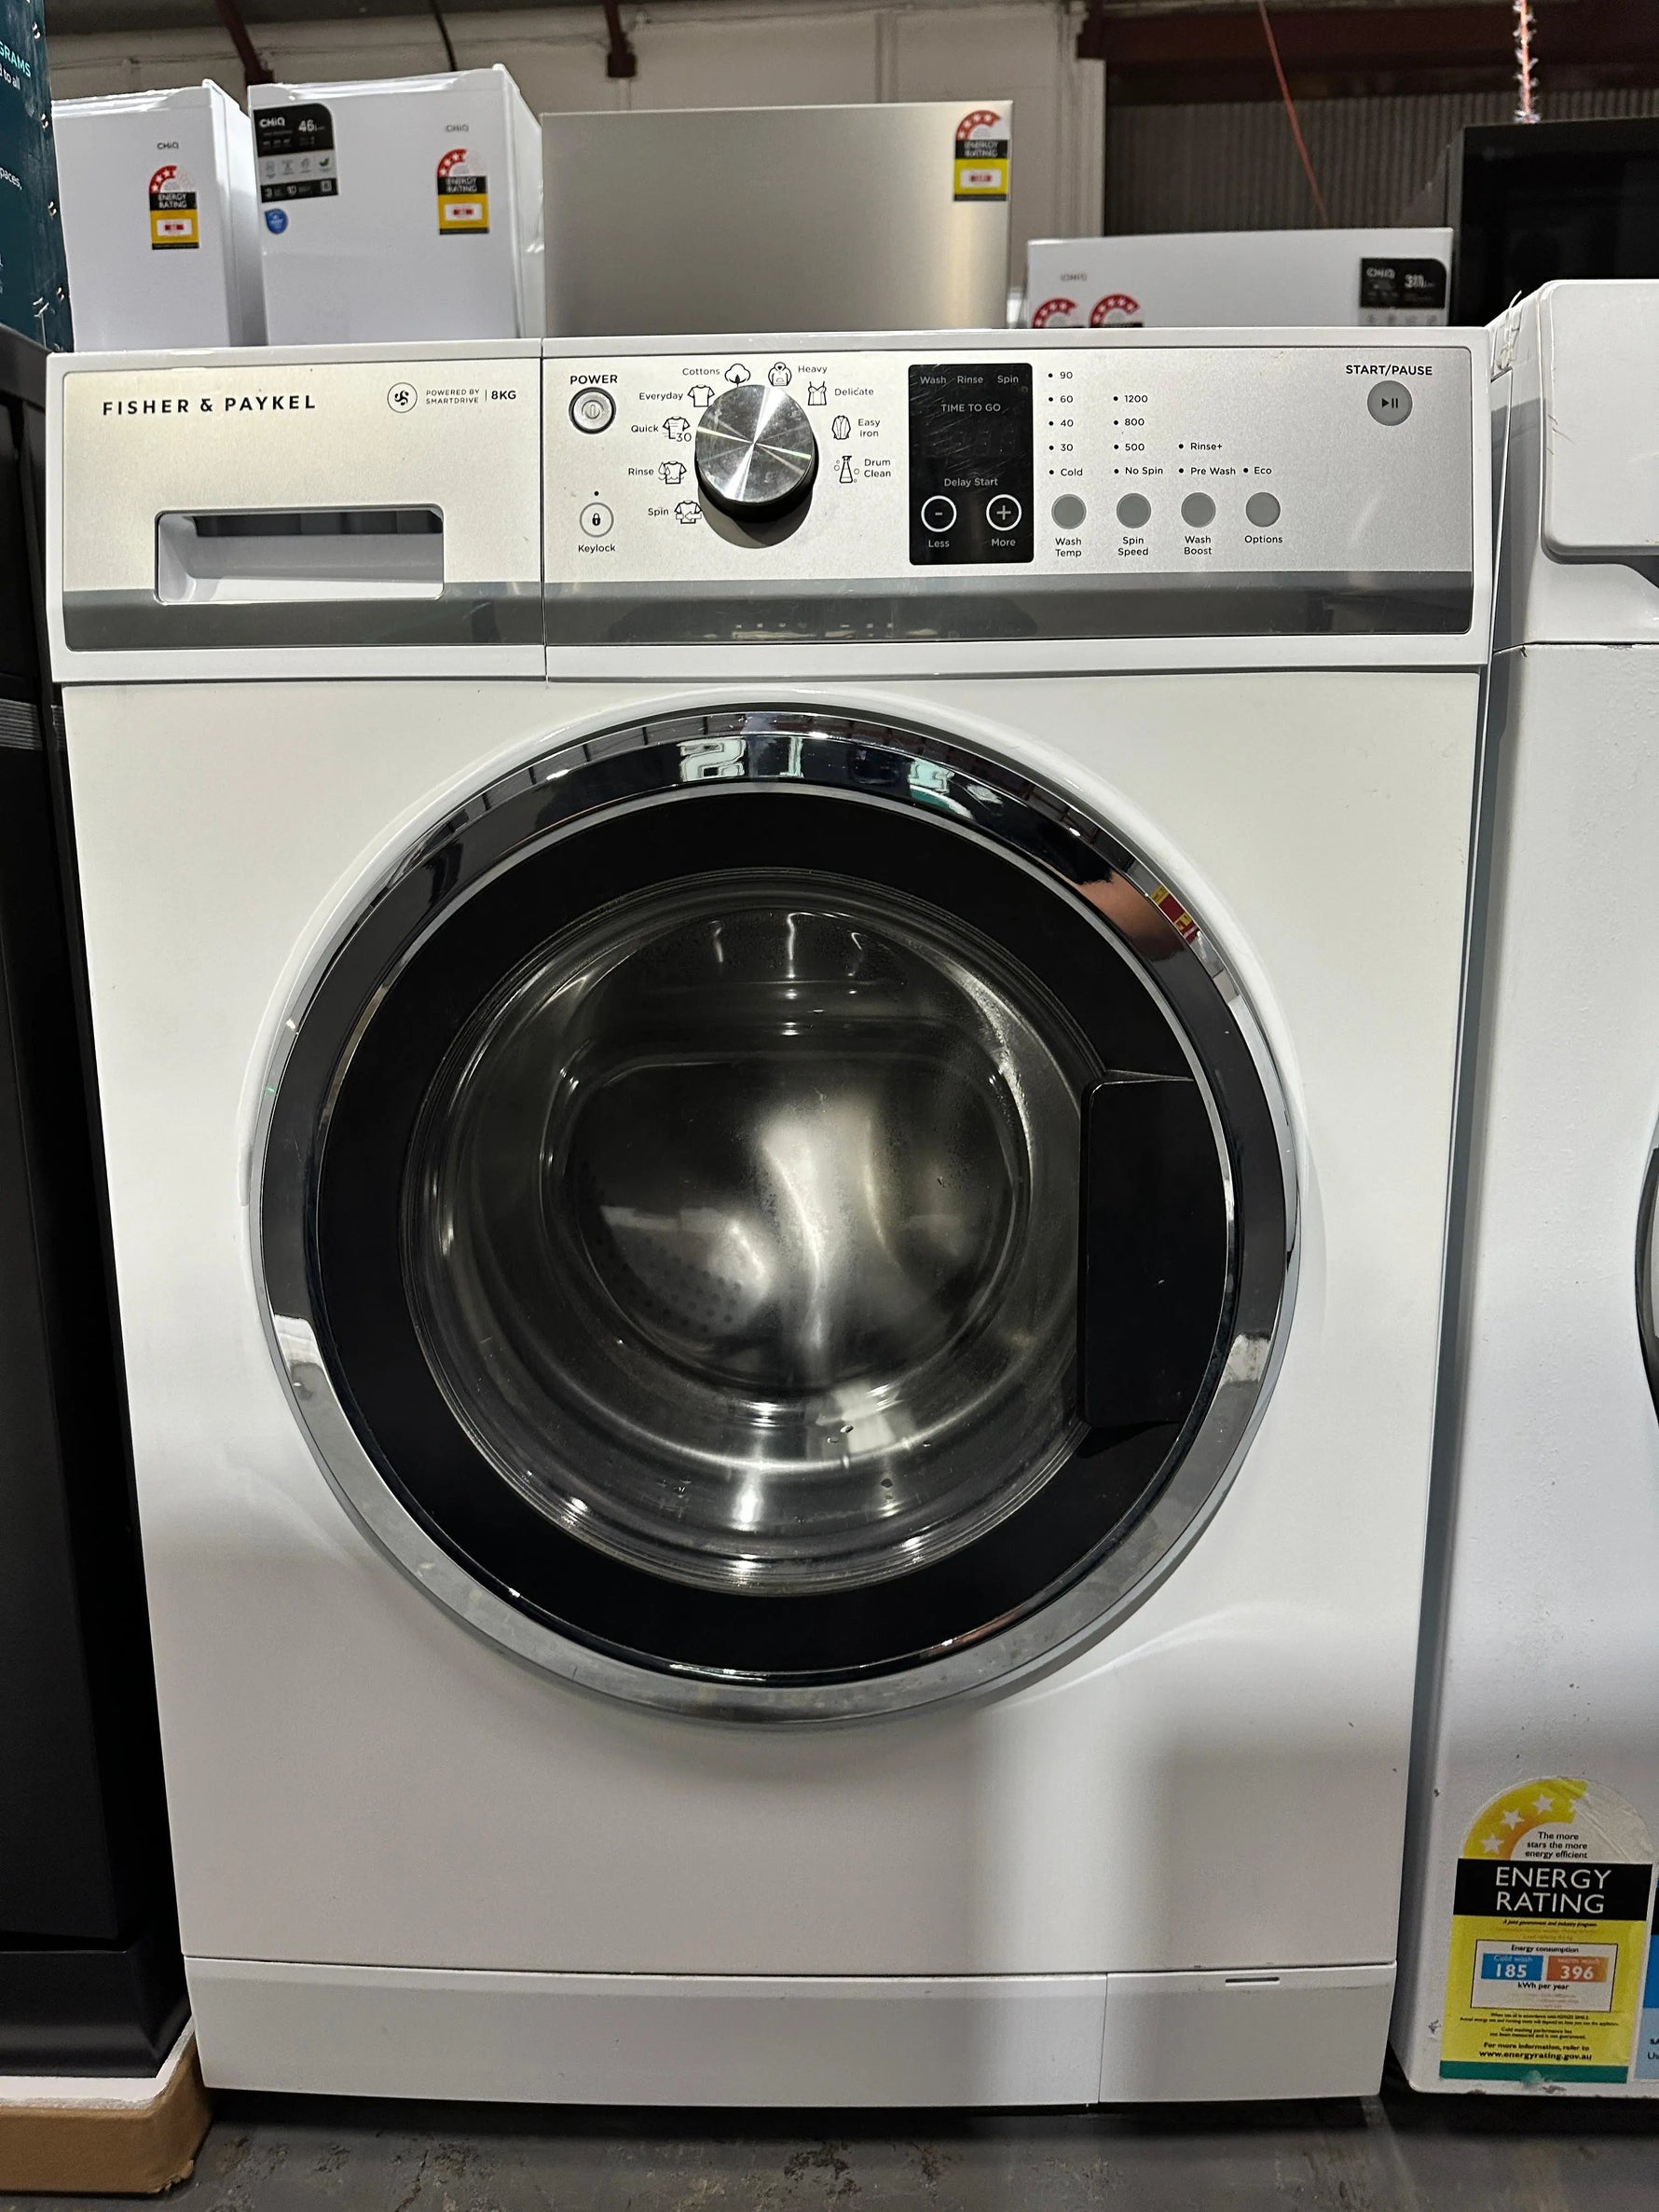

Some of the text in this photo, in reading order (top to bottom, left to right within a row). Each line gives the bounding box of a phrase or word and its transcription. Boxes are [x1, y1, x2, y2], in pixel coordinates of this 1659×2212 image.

[681, 367, 720, 377] Cottons
[798, 364, 828, 375] Heavy
[1345, 364, 1433, 377] START/PAUSE
[569, 374, 618, 385] POWER
[1059, 371, 1074, 379] 90
[919, 375, 1020, 386] Wash Rinse Spin
[426, 389, 467, 397] POWERED
[490, 390, 516, 401] 8KG
[638, 392, 684, 402] Everyday
[834, 388, 874, 396] Delicate
[425, 396, 479, 405] SMARTDRIVE
[1060, 394, 1074, 404] 60
[1124, 394, 1148, 404] 1200
[103, 394, 316, 416] FISHER & PAYKEL
[940, 403, 1002, 413] TIME TO GO
[857, 418, 881, 428] Easy
[1060, 419, 1075, 428] 40
[1124, 418, 1145, 427] 800
[630, 424, 659, 433] Quick
[676, 432, 692, 443] 30
[859, 430, 879, 438] Iron
[1060, 443, 1074, 452] 30
[1125, 443, 1145, 452] 500
[1190, 442, 1223, 451] Rinse+
[864, 458, 891, 467] Drum
[627, 467, 654, 476] Rinse
[863, 469, 892, 478] Clean
[1060, 467, 1083, 477] Cold
[1125, 466, 1164, 476] No Spin
[1190, 466, 1237, 475] Pre Wash
[1254, 466, 1272, 475] Eco
[943, 476, 999, 488] Delay Start
[648, 507, 669, 517] Spin
[927, 537, 950, 548] Less
[991, 537, 1016, 547] More
[1054, 537, 1082, 546] Wash
[1122, 536, 1145, 546] Spin
[1184, 535, 1212, 544] Wash
[1244, 534, 1283, 545] Options
[578, 543, 616, 554] Keylock
[1054, 548, 1082, 558] Temp
[1117, 547, 1149, 557] Speed
[1184, 546, 1213, 556] Boost
[1538, 1831, 1555, 1840] The
[1527, 1840, 1547, 1849] stars
[1549, 1841, 1563, 1850] the
[1525, 1849, 1588, 1860] energy efficient
[1495, 1866, 1611, 1889] ENERGY
[1495, 1890, 1605, 1915] RATING
[1511, 1944, 1535, 1954] Energy
[1496, 1963, 1528, 1978] 185
[1560, 1965, 1594, 1980] 396
[1517, 1982, 1537, 1990] kWh
[1518, 2043, 1561, 2052] information,
[1479, 2052, 1593, 2061] www.energyrating.gov.au
